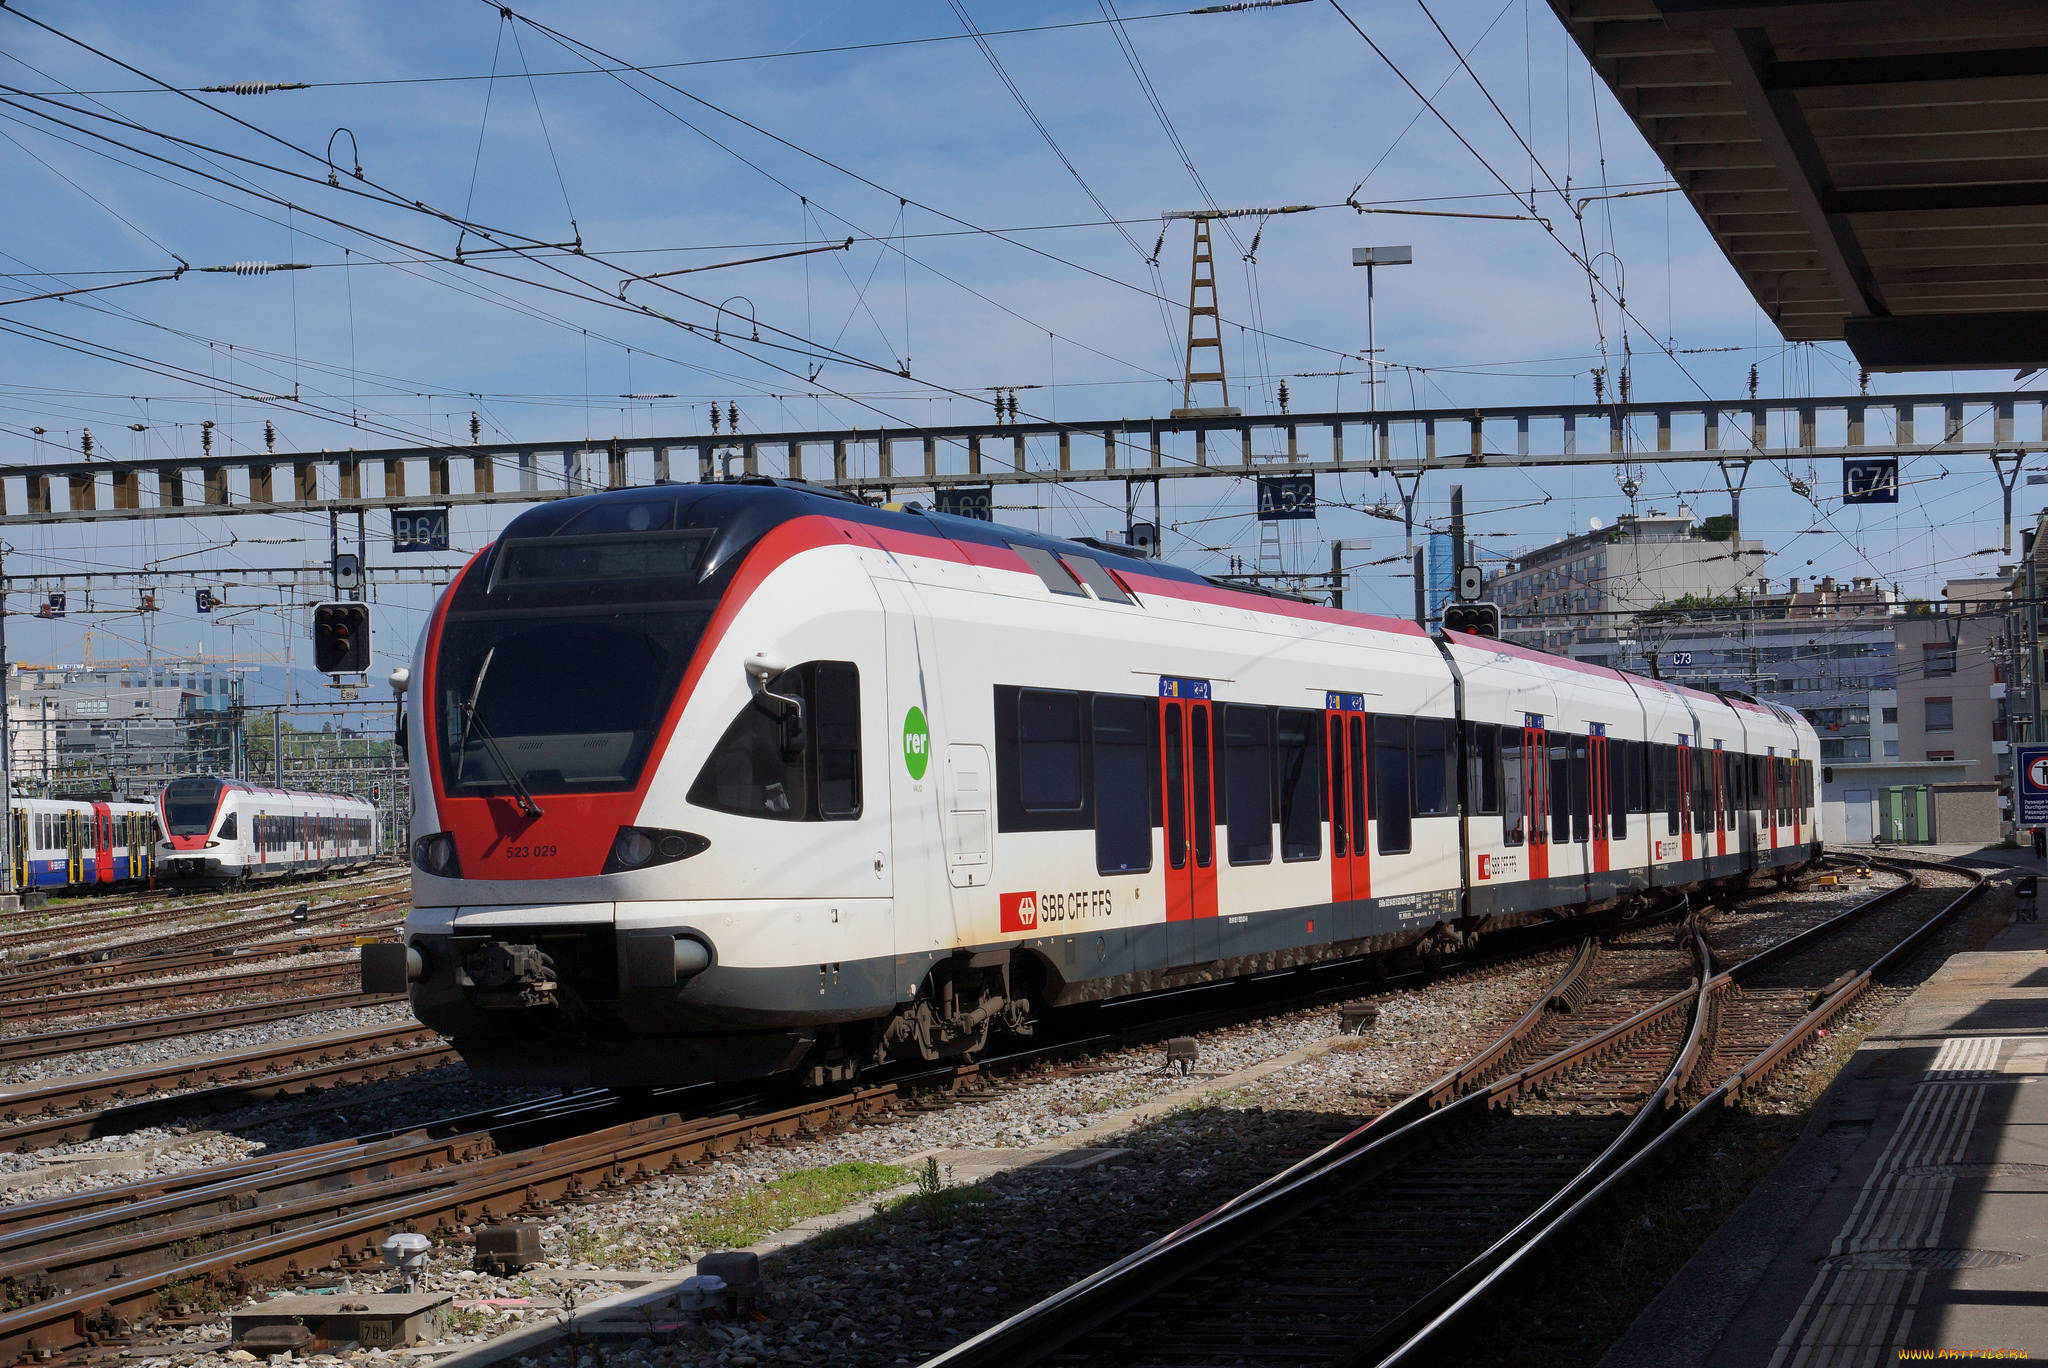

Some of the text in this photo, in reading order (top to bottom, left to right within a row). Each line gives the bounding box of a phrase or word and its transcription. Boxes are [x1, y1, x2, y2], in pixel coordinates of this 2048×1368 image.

[200, 593, 208, 609] 6
[1673, 652, 1692, 665] C73
[1163, 680, 1168, 696] 2
[1203, 683, 1208, 699] 2
[905, 733, 926, 754] rer
[506, 845, 557, 858] 523 029
[1042, 889, 1112, 922] SBB CFF FFS
